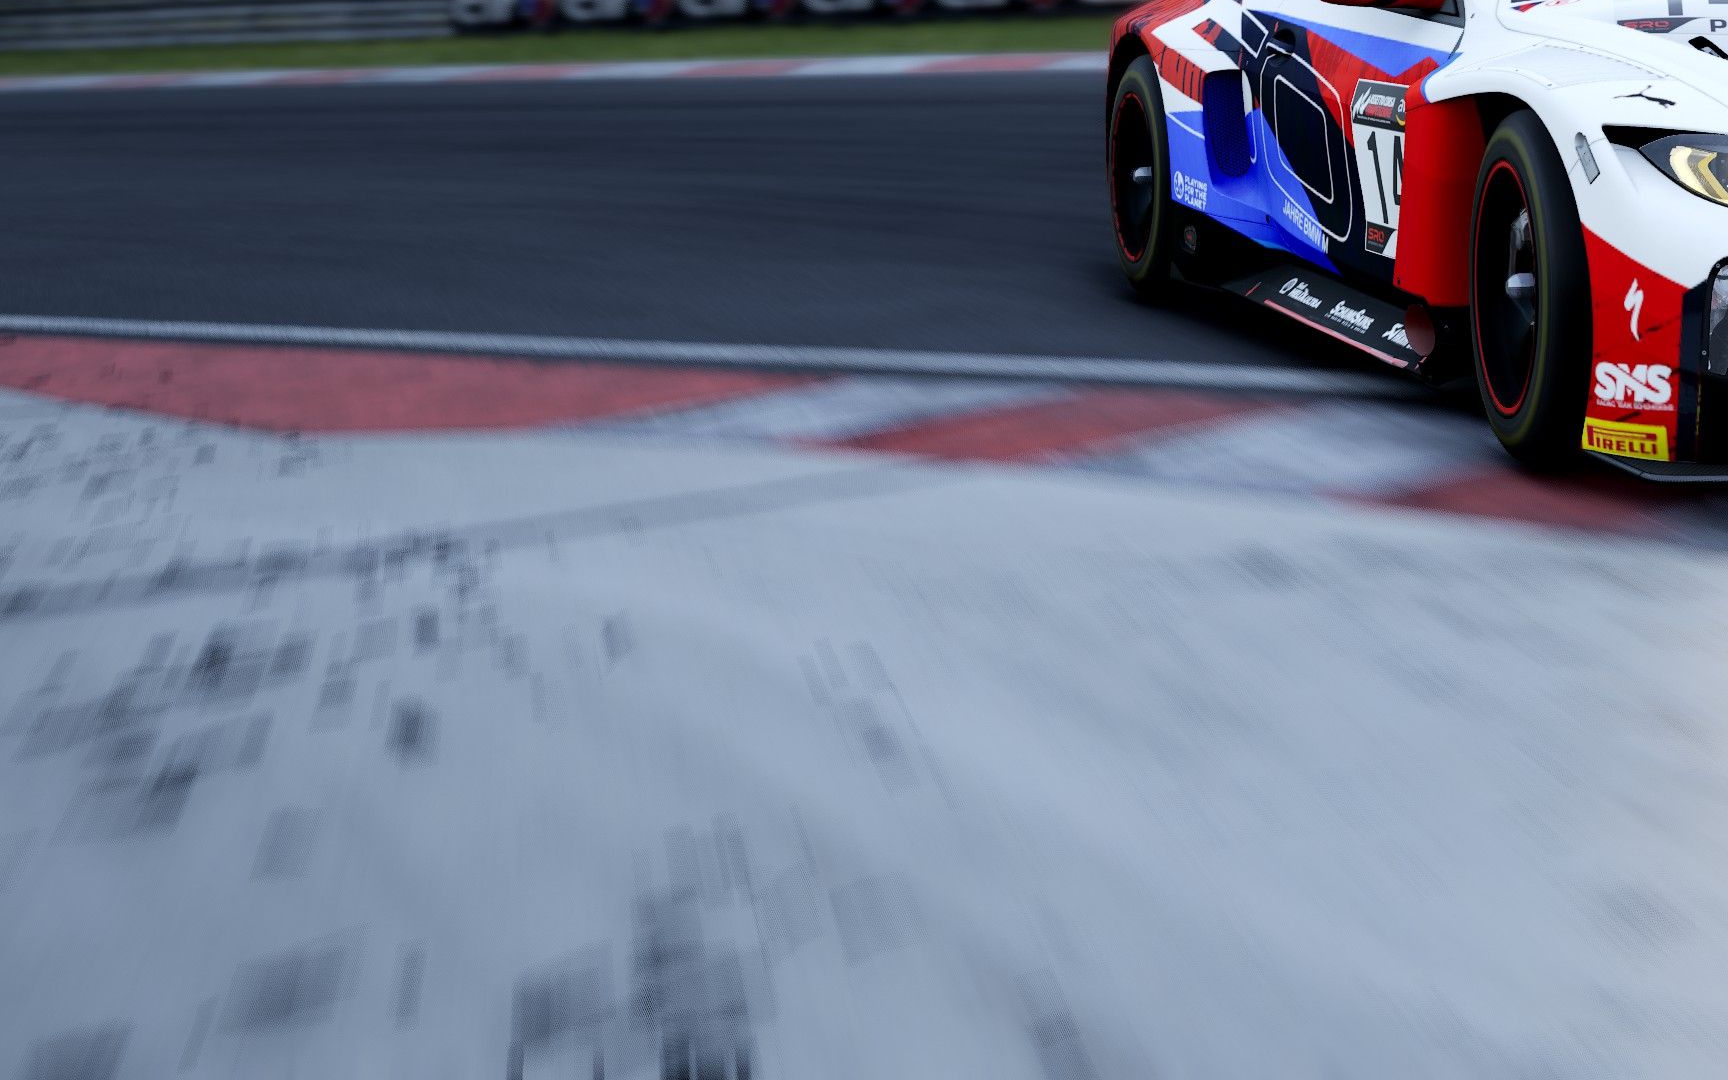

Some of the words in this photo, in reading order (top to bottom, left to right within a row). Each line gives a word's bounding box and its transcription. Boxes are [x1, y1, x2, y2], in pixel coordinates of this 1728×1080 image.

[1184, 175, 1208, 191] PLAYING
[1184, 185, 1195, 196] FOR
[1195, 187, 1207, 201] THE
[1184, 196, 1207, 211] PLANET
[1282, 199, 1303, 231] JAHRE
[1303, 218, 1322, 246] BMW
[1594, 361, 1672, 404] SMS
[1586, 425, 1658, 455] PIRELLI
